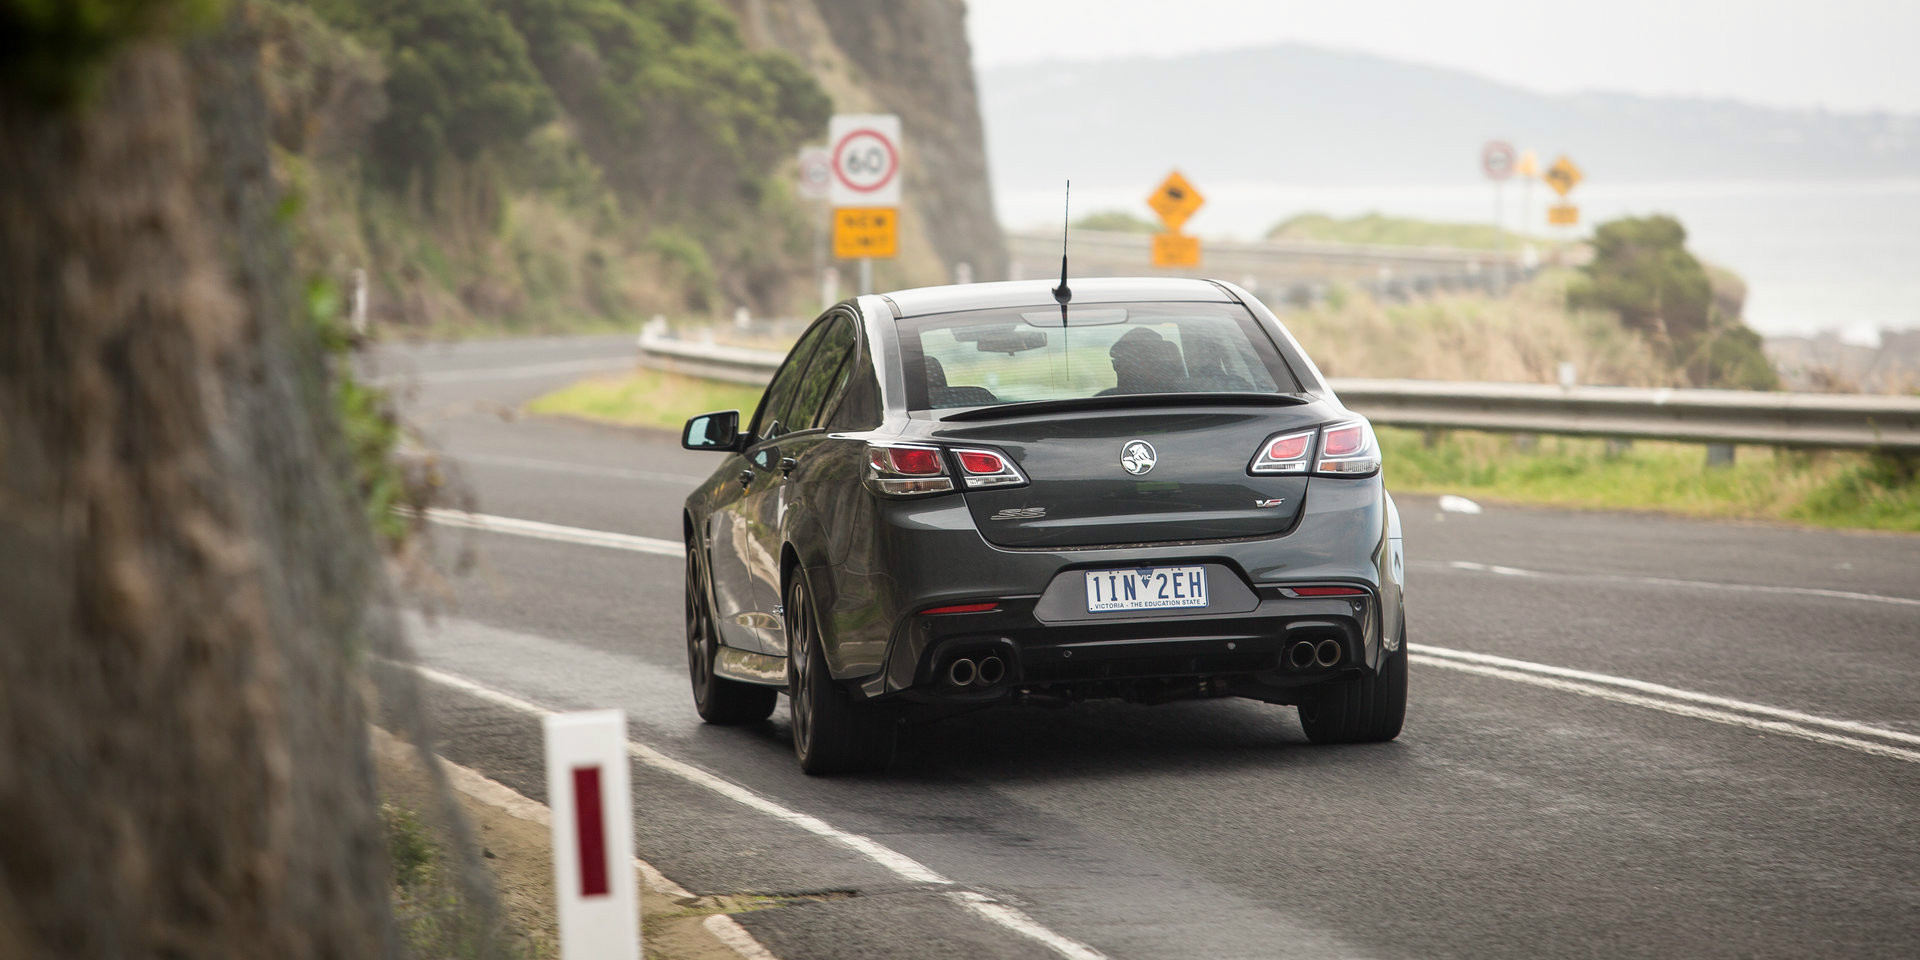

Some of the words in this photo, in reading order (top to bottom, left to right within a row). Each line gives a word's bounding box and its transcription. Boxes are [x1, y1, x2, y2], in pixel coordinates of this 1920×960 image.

[846, 147, 884, 175] 60
[842, 213, 888, 230] NEW
[990, 507, 1046, 520] SS
[1095, 602, 1125, 610] VICTORIA
[1182, 598, 1201, 606] STATE
